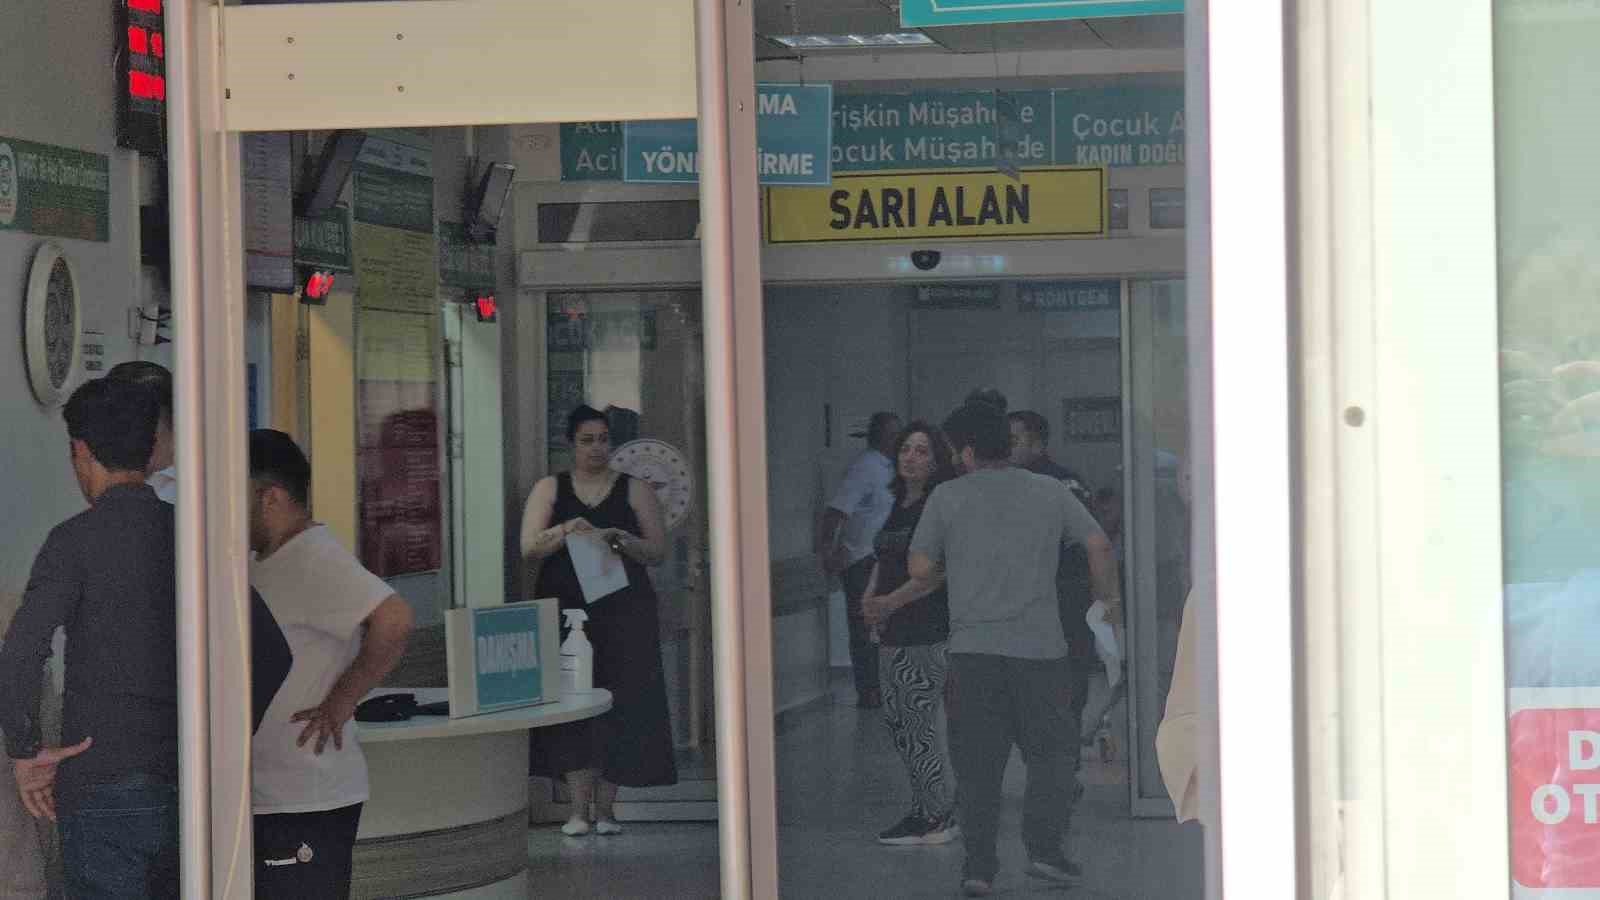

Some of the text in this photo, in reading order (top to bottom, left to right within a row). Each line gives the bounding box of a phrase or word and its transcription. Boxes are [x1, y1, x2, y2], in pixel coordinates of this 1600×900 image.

[759, 94, 797, 115] MA
[833, 101, 1034, 131] rişkin Müşahe
[1073, 111, 1184, 140] Çocuk A
[833, 134, 1044, 163] ocuk Müşahde
[1076, 144, 1132, 164] KADIN
[829, 185, 1030, 229] SARI ALAN
[1568, 730, 1600, 771] D
[1531, 783, 1600, 825] OT
